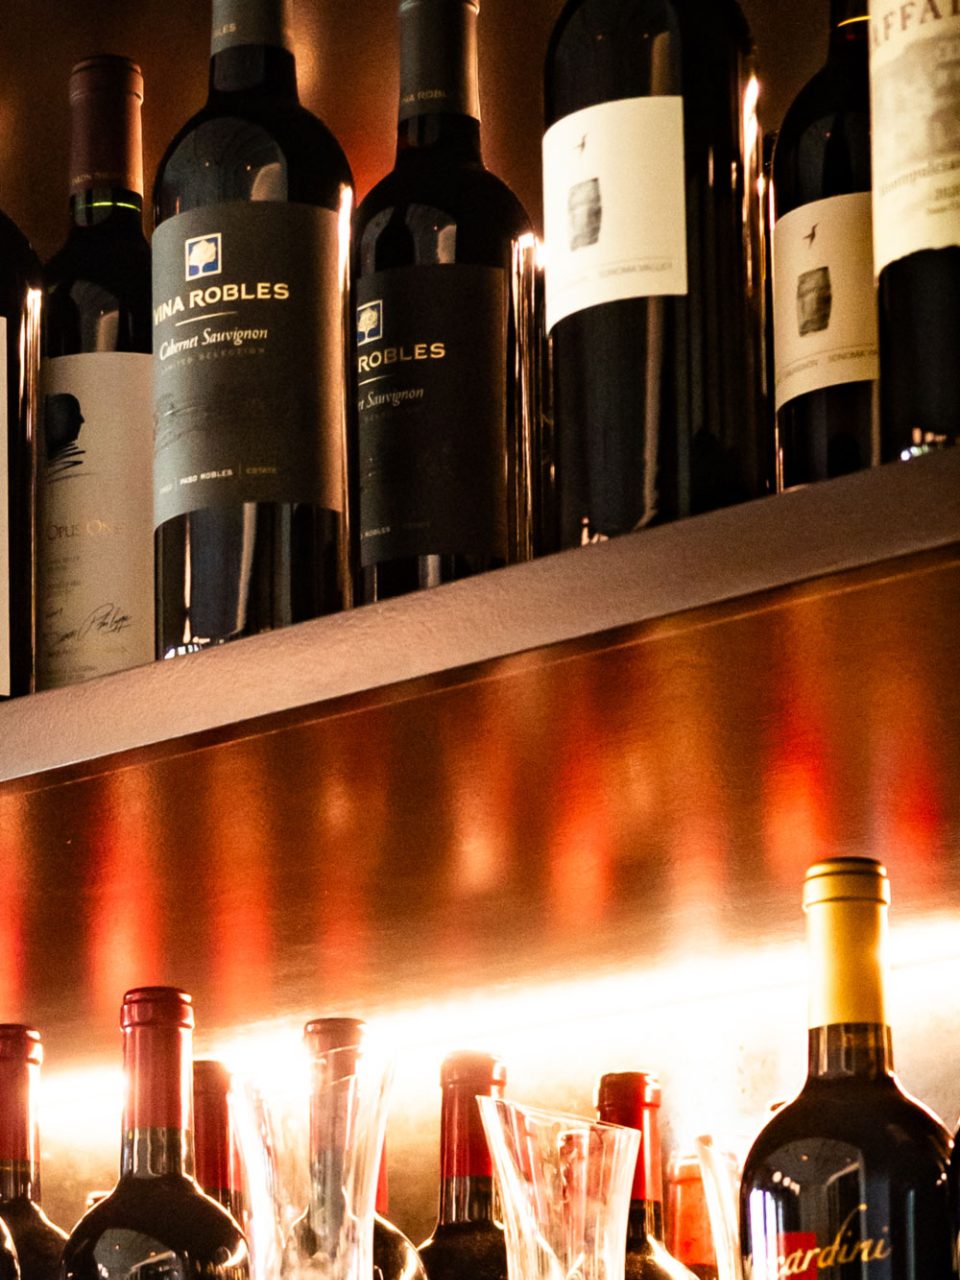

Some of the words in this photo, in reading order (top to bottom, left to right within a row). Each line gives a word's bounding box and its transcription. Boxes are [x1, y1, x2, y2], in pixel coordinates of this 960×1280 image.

[189, 281, 290, 310] ROBLES
[159, 336, 200, 361] Cabernet
[202, 327, 269, 347] Sauvignon
[357, 342, 447, 374] ROBLES
[366, 388, 425, 408] Sauvignon
[200, 468, 234, 481] ROBLES
